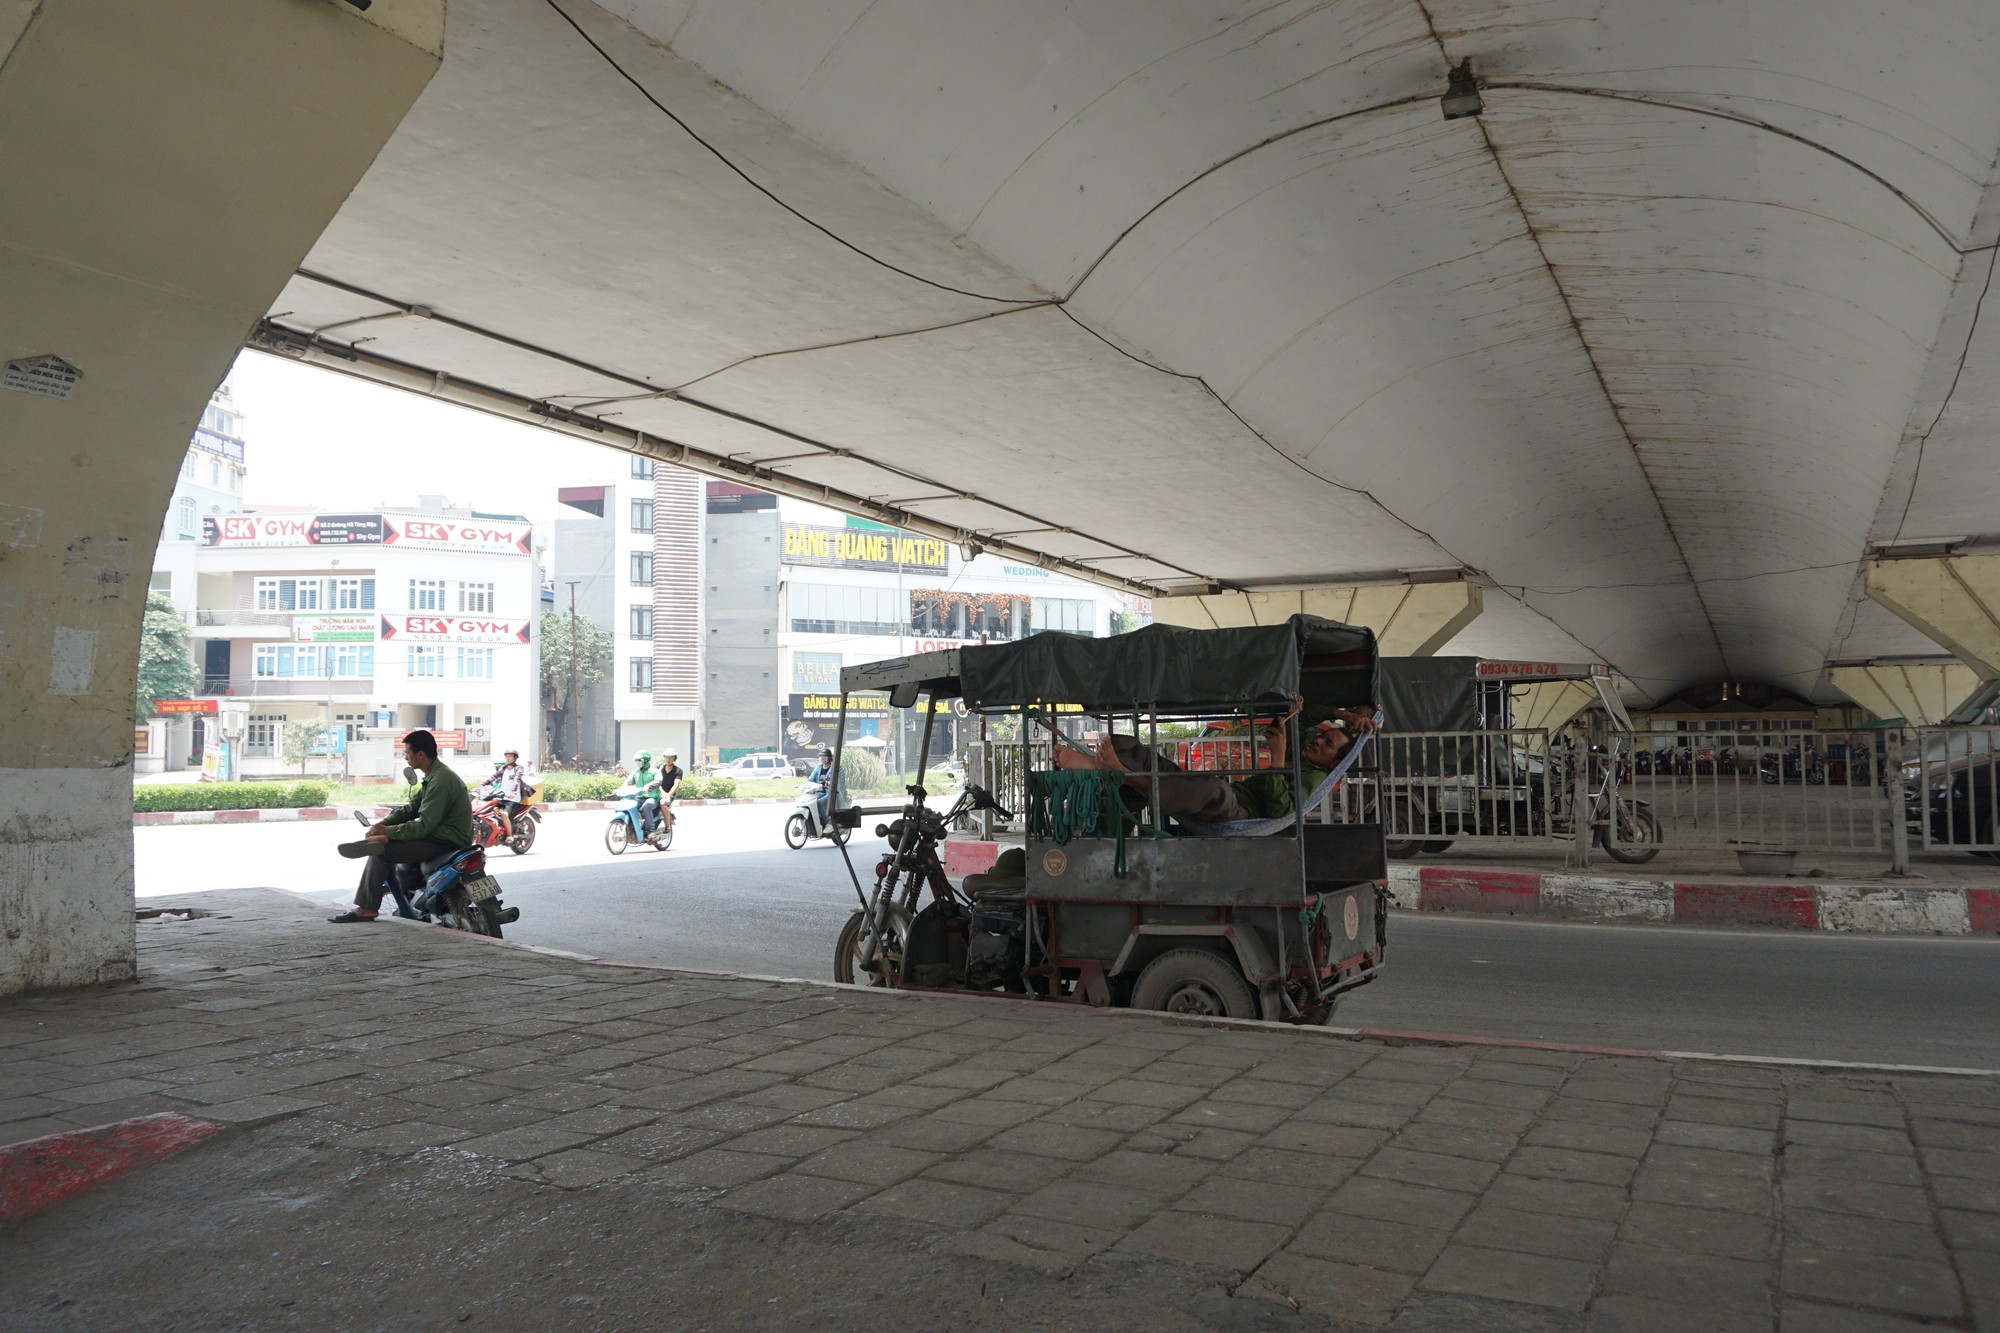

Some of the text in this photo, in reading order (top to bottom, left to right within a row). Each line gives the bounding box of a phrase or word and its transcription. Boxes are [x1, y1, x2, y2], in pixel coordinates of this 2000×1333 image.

[225, 517, 305, 539] SKY GYM
[405, 521, 512, 543] SKY GYM
[785, 524, 945, 566] ĐĂNG QUANG WATCH
[1004, 566, 1050, 578] WEDDING
[406, 616, 508, 634] SKY GYM
[797, 662, 838, 675] BELLA
[1480, 664, 1558, 675] 0934 476 476
[803, 694, 828, 710] ĐĂNG
[830, 697, 856, 710] QUNG
